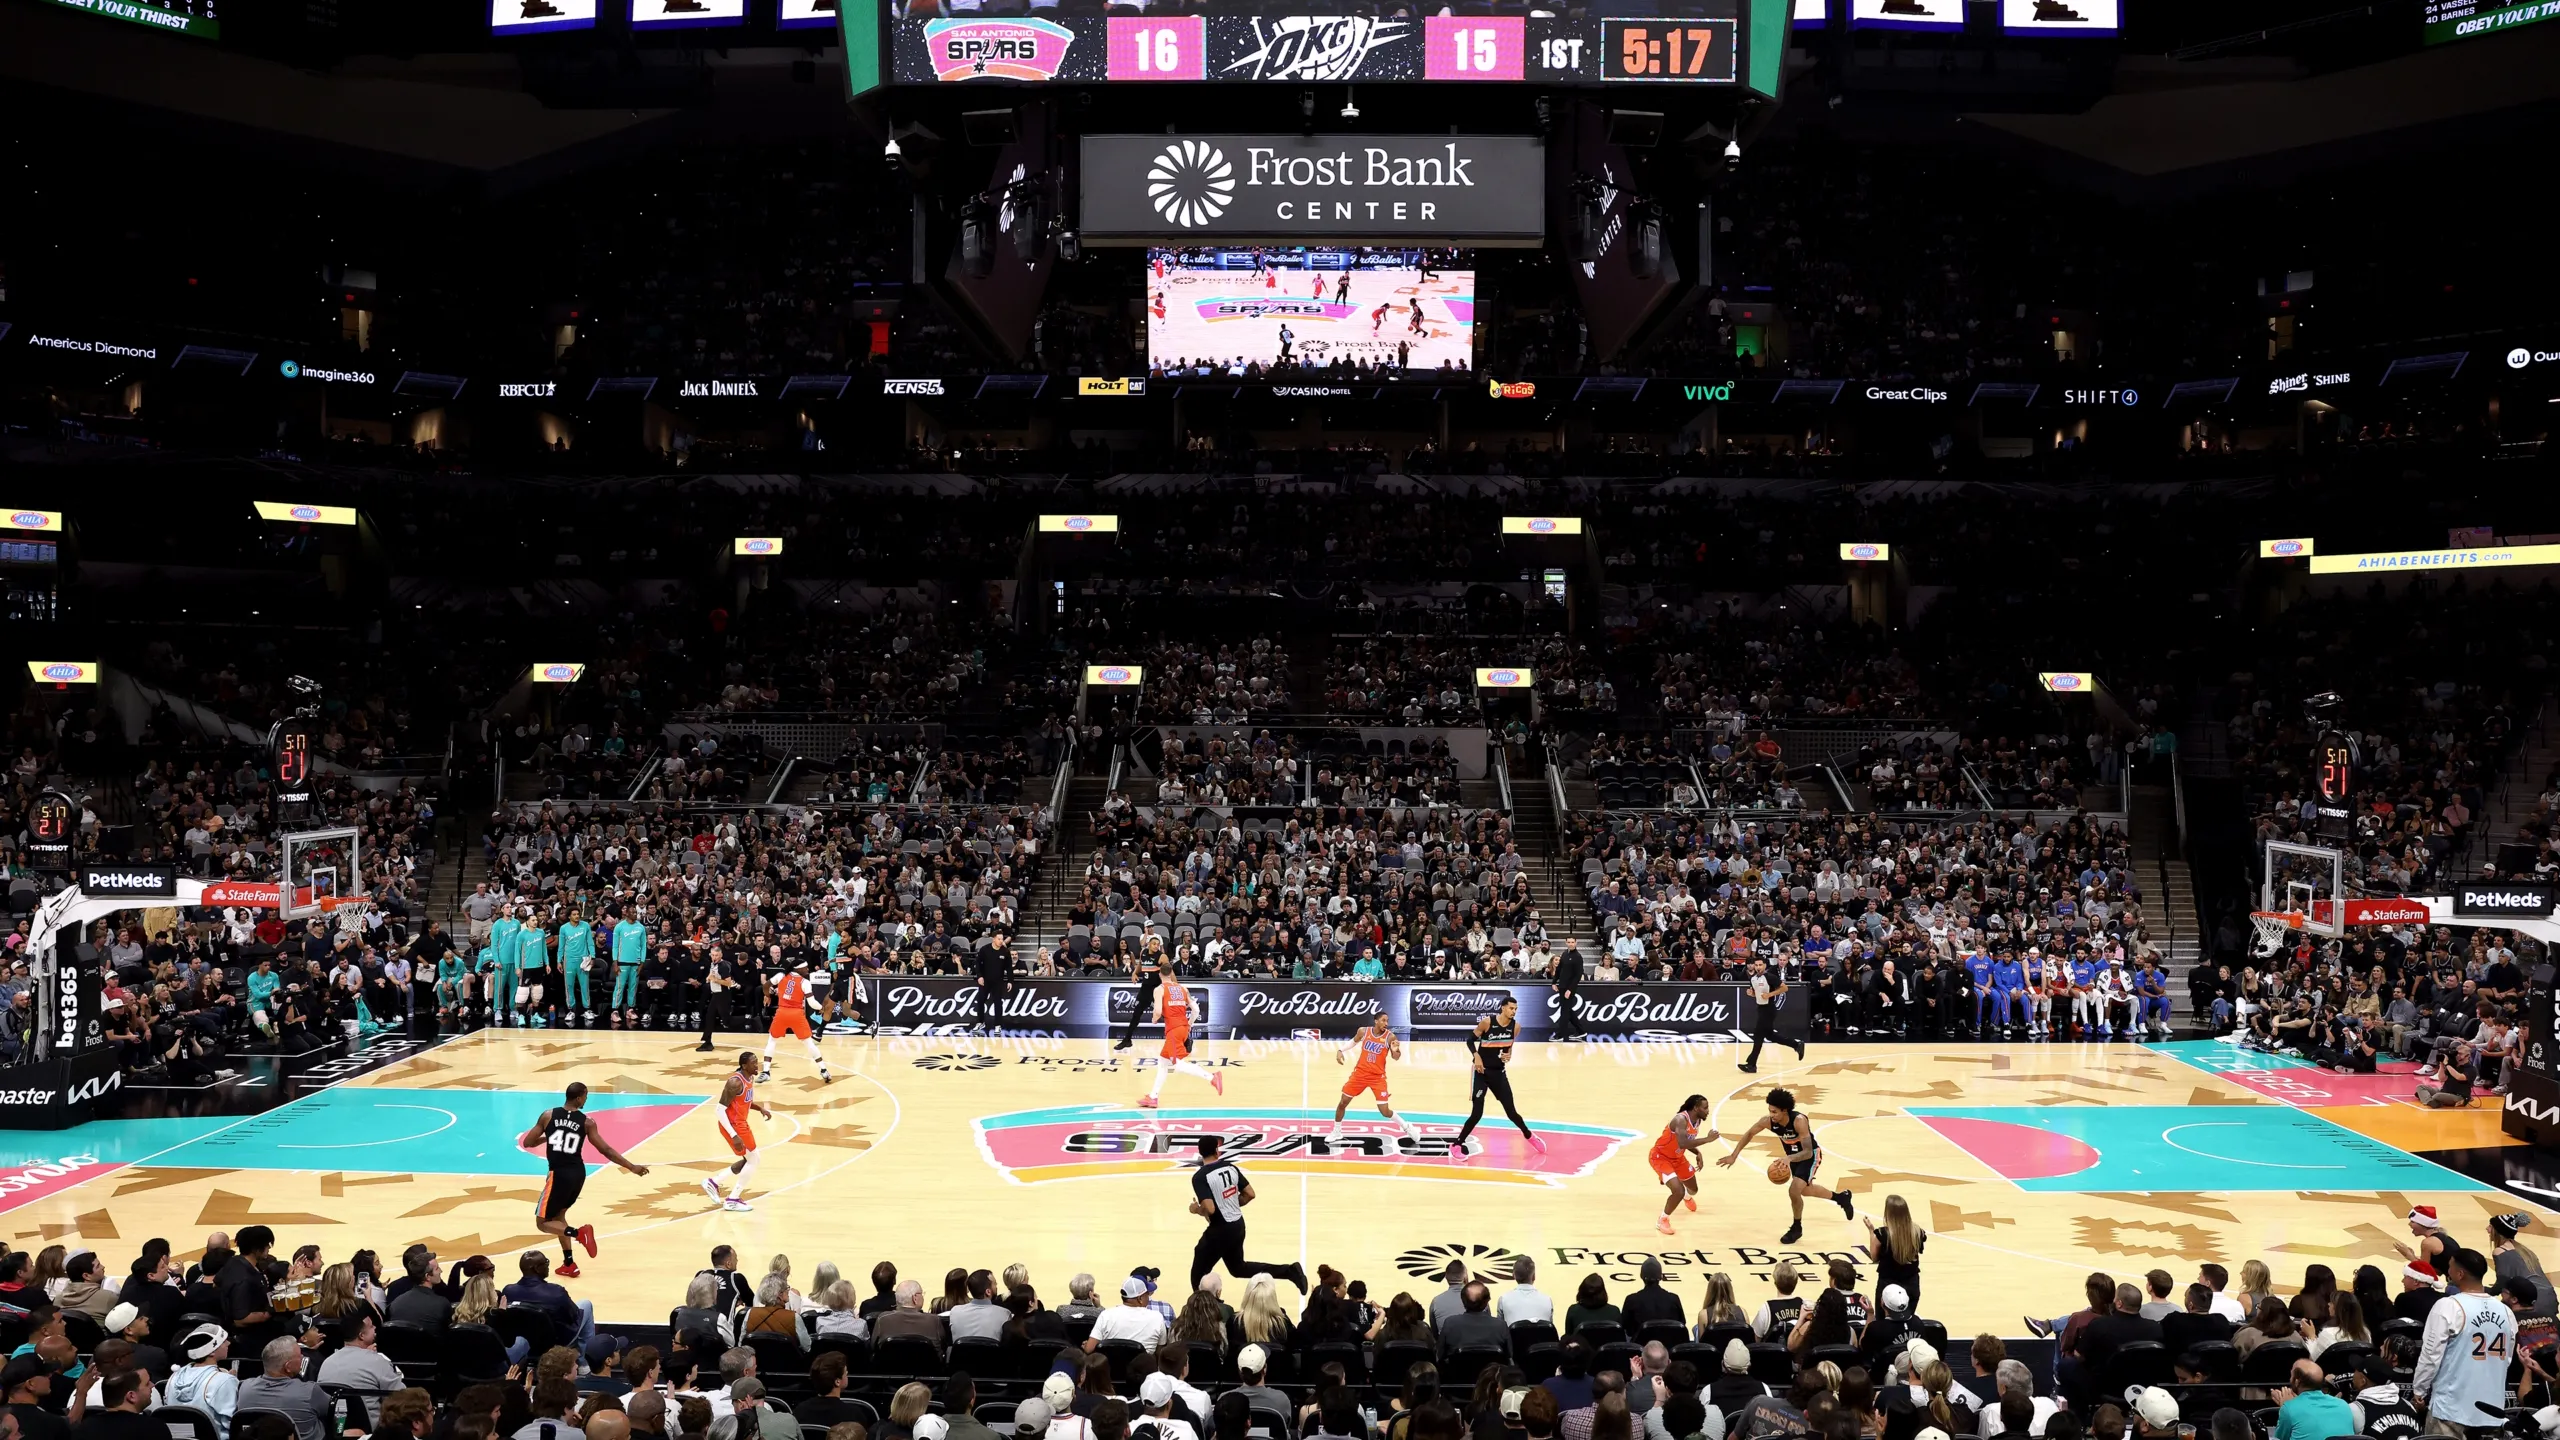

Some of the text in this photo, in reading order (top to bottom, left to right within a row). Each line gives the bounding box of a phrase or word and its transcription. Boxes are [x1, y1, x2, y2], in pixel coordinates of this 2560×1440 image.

[97, 0, 137, 18] YOUR
[140, 8, 190, 30] THIRST
[2425, 4, 2438, 14] 24
[2425, 7, 2475, 24] 40 BARNES
[2455, 15, 2496, 35] OBEY
[2496, 6, 2539, 26] YOUR
[951, 29, 1035, 37] SAN ANTONIO
[947, 38, 1036, 66] SPURS
[1135, 29, 1178, 71] 16
[1270, 20, 1348, 74] OKC
[1453, 29, 1497, 71] 15
[1541, 39, 1584, 69] 1ST
[1623, 28, 1712, 74] 5:17
[1247, 142, 1475, 186] Frost Bank
[1277, 202, 1437, 220] CENTER
[29, 334, 156, 359] Americus Diamond
[1380, 340, 1421, 348] Bak
[2534, 351, 2560, 362] Ow
[302, 365, 375, 384] imagine360
[499, 384, 547, 397] RBFCU
[680, 380, 710, 397] JACK
[884, 379, 942, 395] KENS5
[1087, 381, 1144, 391] HOLT CAT
[2269, 372, 2308, 394] Shiner
[1290, 386, 1330, 397] CASINO
[1866, 387, 1947, 402] Great Clips
[17, 515, 41, 524] AHIA
[296, 508, 318, 519] AHIA
[1067, 518, 1088, 528] AHIA
[1531, 521, 1551, 530] AHIA
[749, 542, 769, 551] AHIA
[1855, 548, 1874, 556] AHIA
[2358, 552, 2513, 568] AHIABENEFITS.com
[49, 667, 77, 677] AHIA
[549, 668, 570, 677] AHIA
[1104, 670, 1126, 680] AHIA
[1492, 673, 1514, 682] AHIA
[2056, 678, 2077, 686] AHIA
[286, 734, 306, 750] 5:17
[2327, 748, 2347, 764] 5:17
[281, 751, 305, 780] 21
[2323, 765, 2346, 796] 21
[286, 793, 309, 802] TISSOT
[41, 806, 66, 818] 5:17
[2327, 807, 2349, 818] TISSOT
[39, 819, 61, 835] 21
[41, 844, 69, 852] TISSOT
[89, 872, 163, 888] PetMeds
[2464, 892, 2541, 908] PetMeds
[785, 980, 795, 995] 5
[1168, 986, 1185, 1000] 55
[55, 966, 78, 1048] bet365
[1239, 991, 1382, 1018] ProBaller
[1415, 992, 1501, 1011] ProBaller
[85, 1035, 103, 1047] Frost
[1364, 1040, 1385, 1054] OKC
[288, 1039, 427, 1078] LEDGER
[1015, 1056, 1124, 1066] Frost
[2527, 1055, 2546, 1070] Frost
[2193, 1057, 2333, 1098] LEDGER
[68, 1070, 121, 1105] KIA
[554, 1119, 580, 1131] BARNES
[1092, 1123, 1203, 1131] SAN
[549, 1130, 581, 1154] 40
[1062, 1132, 1484, 1160] SPURS
[1218, 1170, 1233, 1188] 11
[1548, 1246, 1721, 1266] Frost
[2471, 1311, 2505, 1329] VASSELL
[2472, 1332, 2507, 1361] 24
